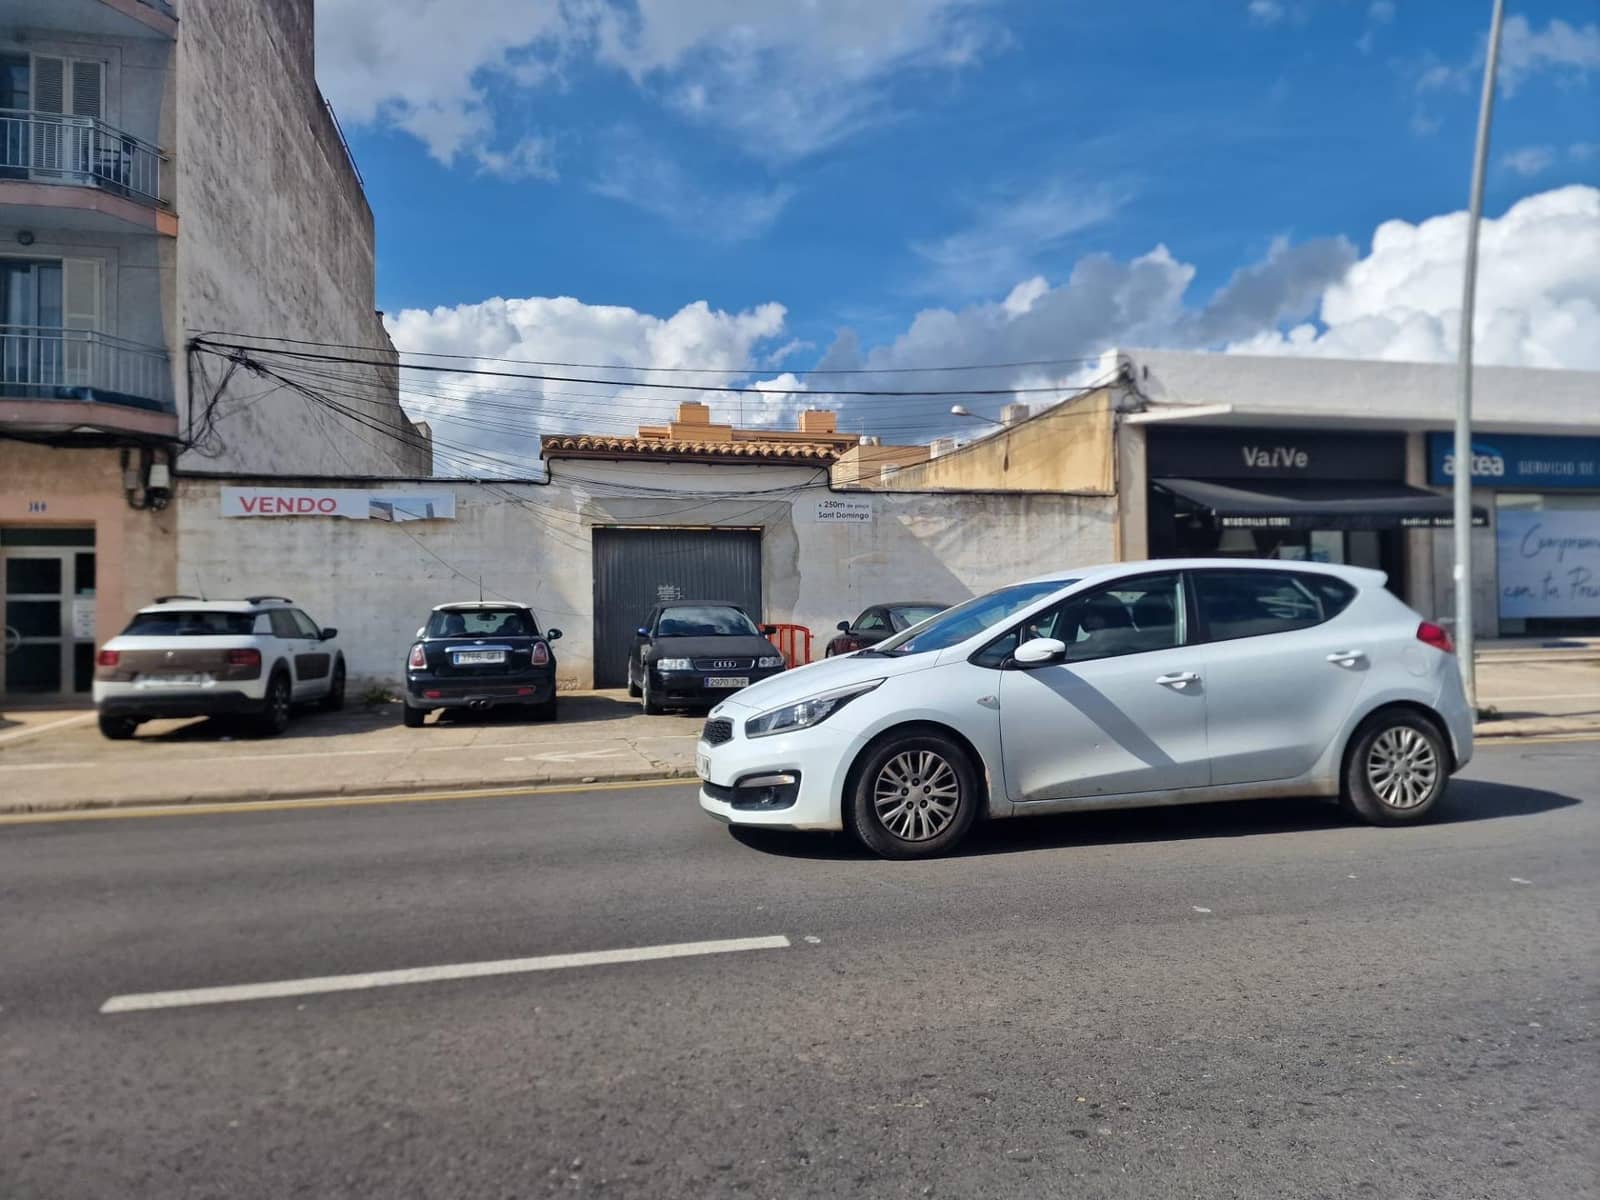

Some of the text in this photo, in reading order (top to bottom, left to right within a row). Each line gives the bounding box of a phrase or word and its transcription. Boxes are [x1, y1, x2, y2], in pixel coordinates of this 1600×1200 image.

[1443, 451, 1505, 476] atea
[239, 496, 337, 513] VENDO
[824, 500, 845, 508] 250m
[818, 511, 869, 520] Sant Domingo
[710, 678, 729, 687] 2970
